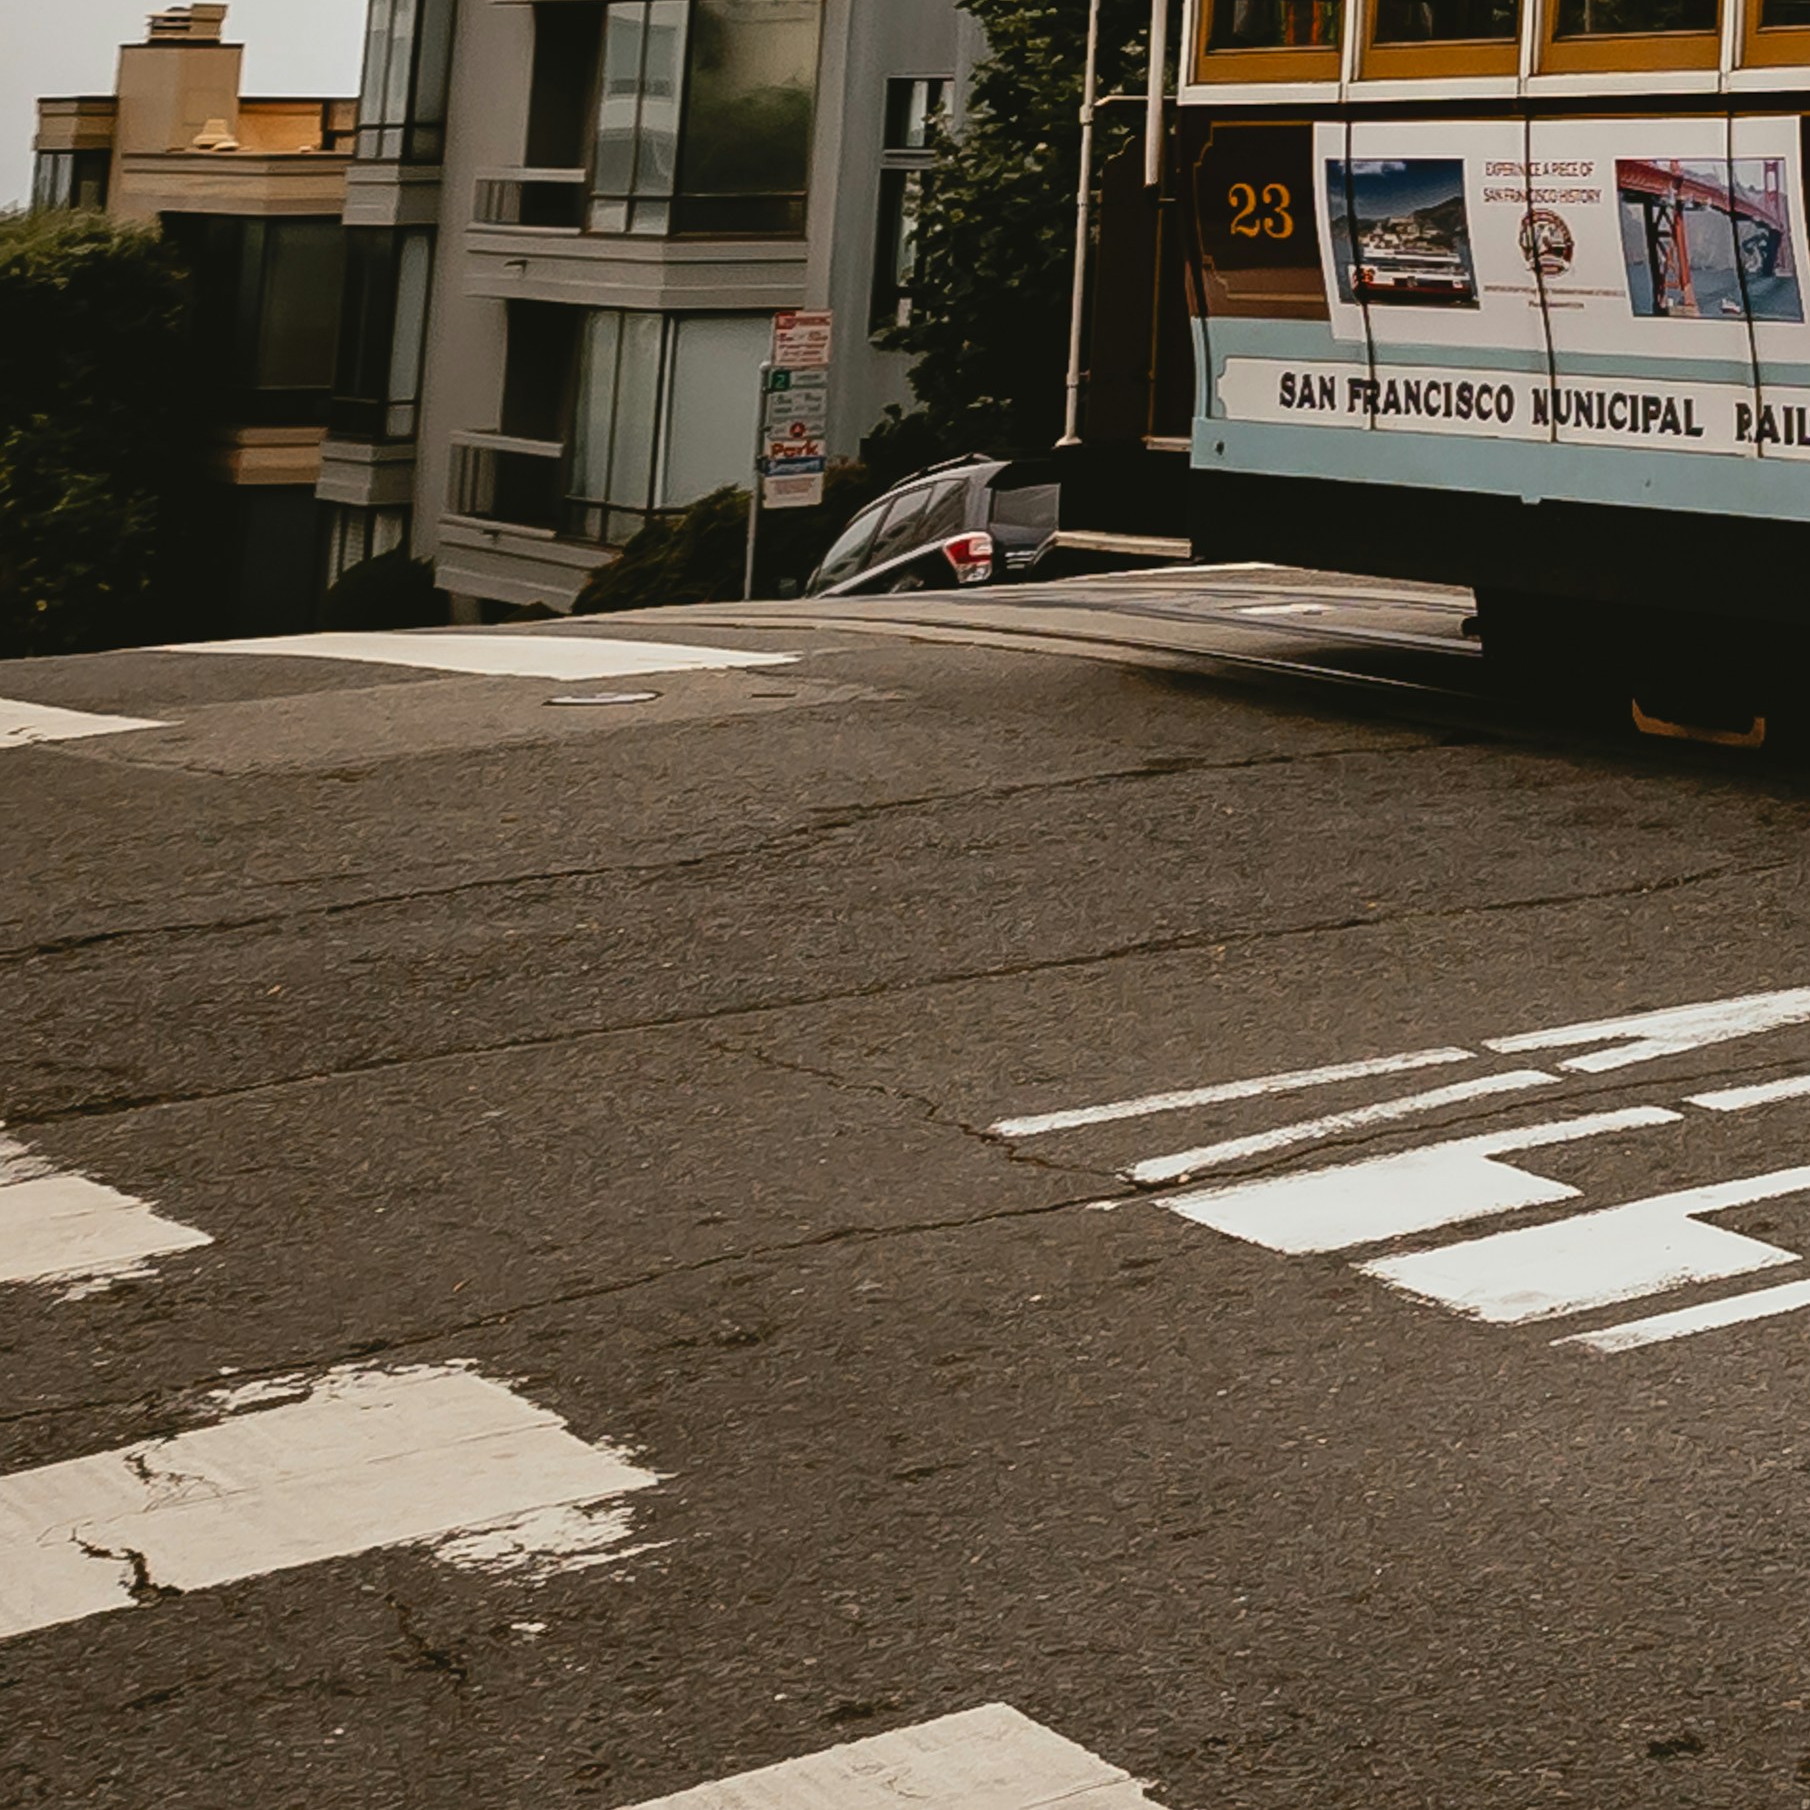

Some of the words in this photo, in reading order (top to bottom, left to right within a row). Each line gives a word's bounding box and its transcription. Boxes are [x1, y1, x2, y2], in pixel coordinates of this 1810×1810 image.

[1228, 183, 1294, 239] 23
[1279, 371, 1337, 411] SAN
[1347, 376, 1515, 423] FRANCISCO
